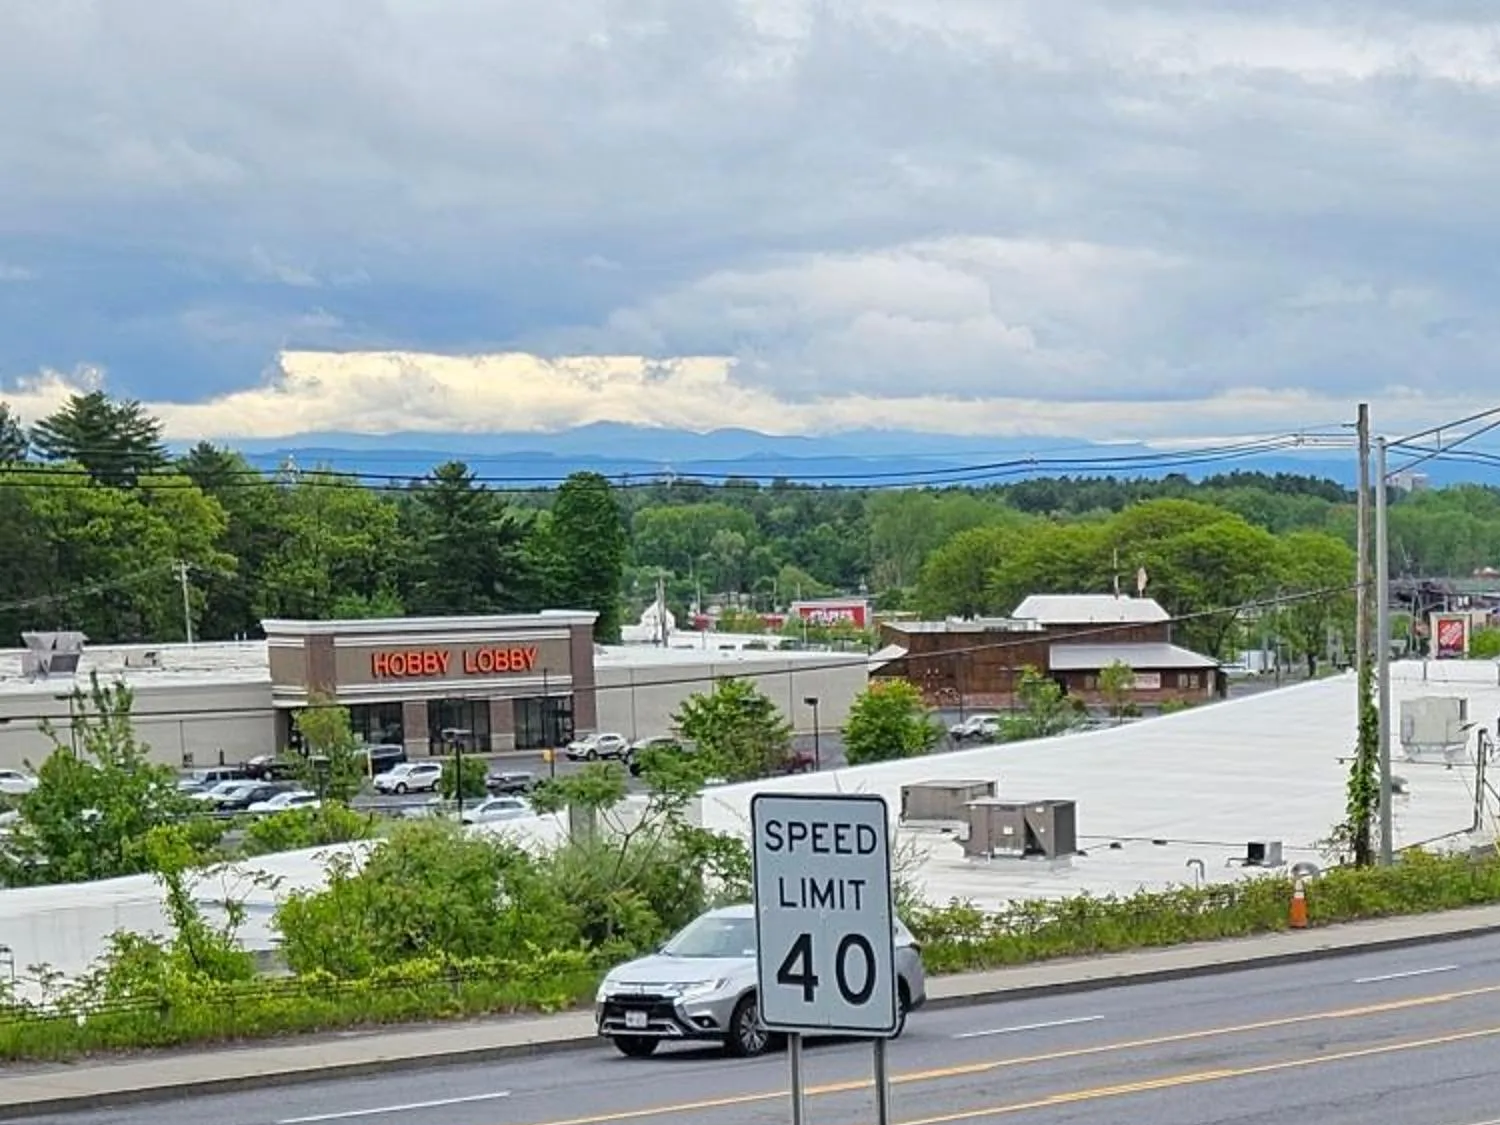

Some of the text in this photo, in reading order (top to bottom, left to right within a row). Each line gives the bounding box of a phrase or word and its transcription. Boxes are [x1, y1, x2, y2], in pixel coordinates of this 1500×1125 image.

[372, 647, 536, 677] HOBBY LOBBY
[765, 820, 877, 854] SPEED
[779, 877, 866, 910] LIMIT
[777, 933, 876, 1005] 40
